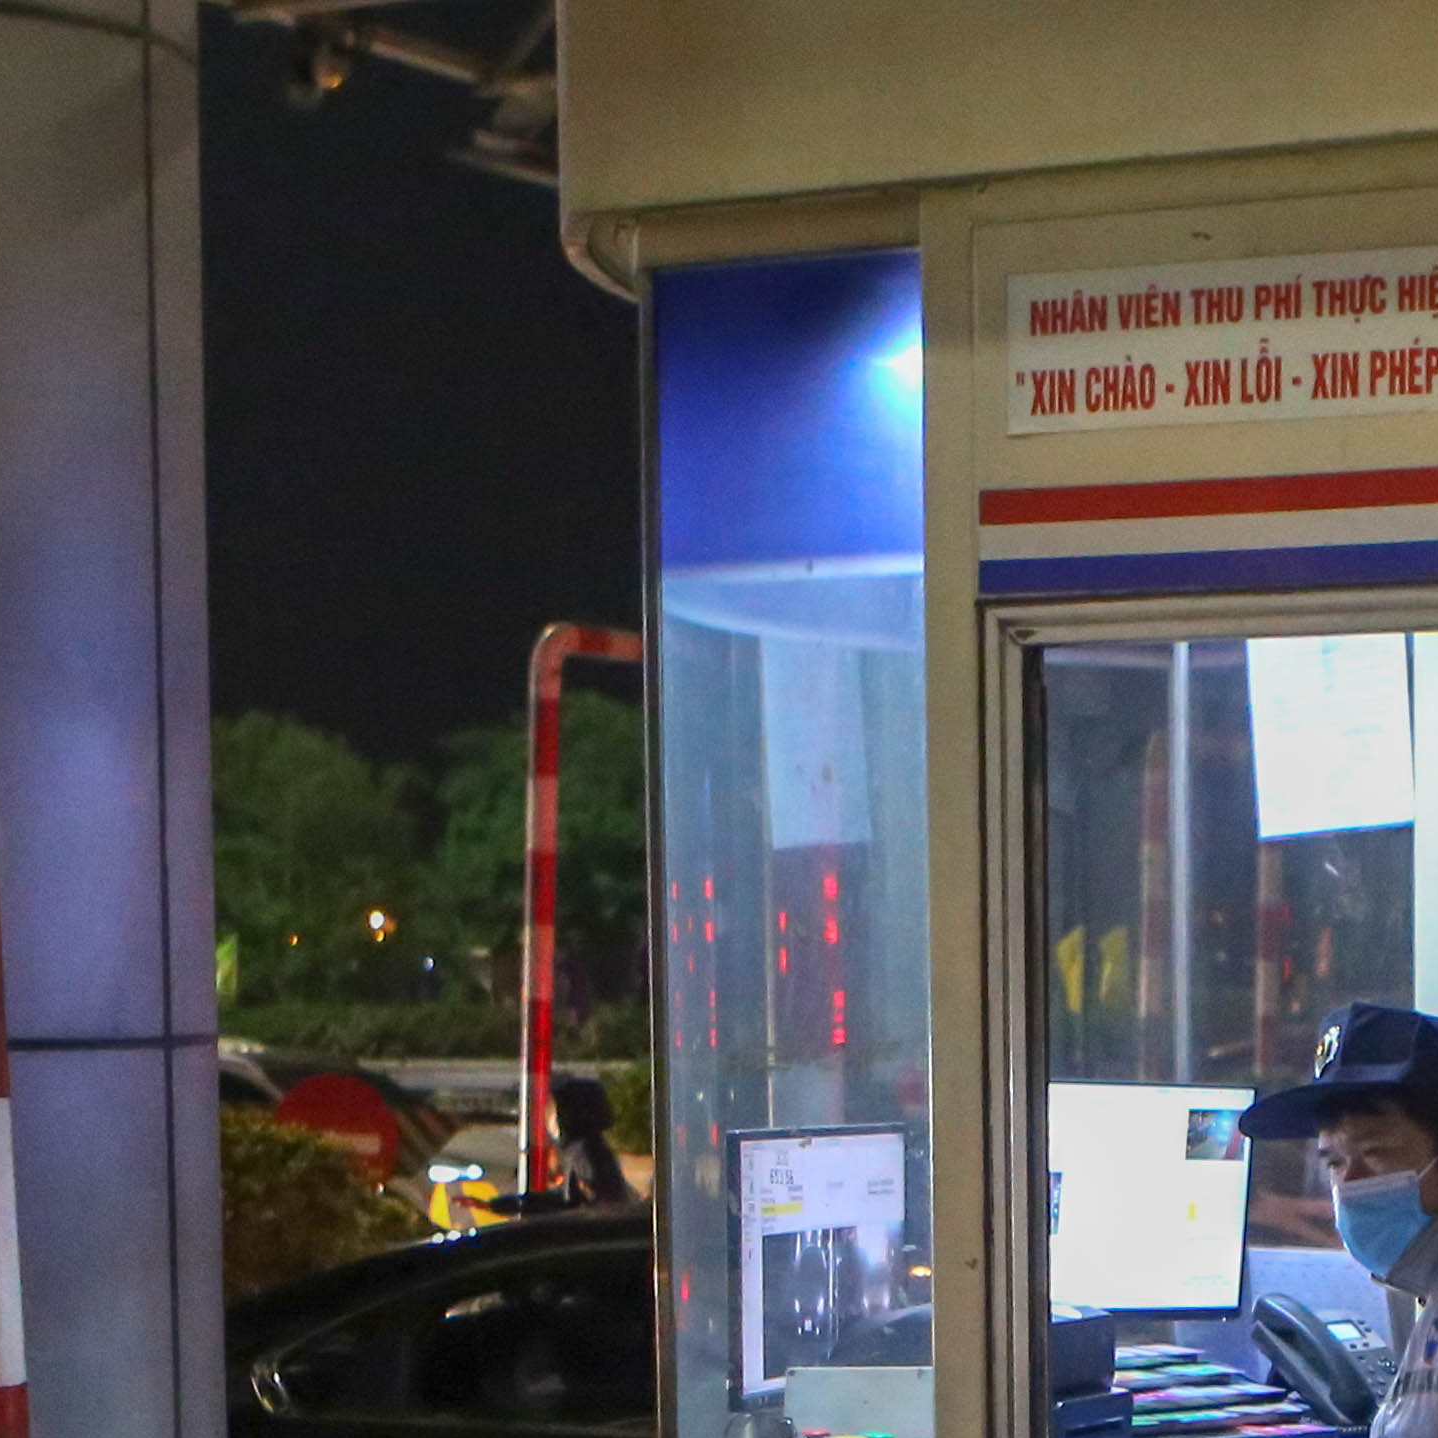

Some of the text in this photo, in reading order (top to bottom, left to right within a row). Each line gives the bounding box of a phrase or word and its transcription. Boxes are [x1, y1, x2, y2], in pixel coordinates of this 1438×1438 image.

[1030, 289, 1108, 336] NHÂN
[1118, 284, 1181, 330] VIÊN
[1190, 286, 1244, 325] THU
[1254, 274, 1302, 320] PHÍ
[1312, 274, 1386, 323] THỰC
[1085, 355, 1156, 412] CHÀO
[1184, 360, 1231, 407] XIN
[1240, 337, 1282, 403] LỖI
[1312, 352, 1359, 400] XIN
